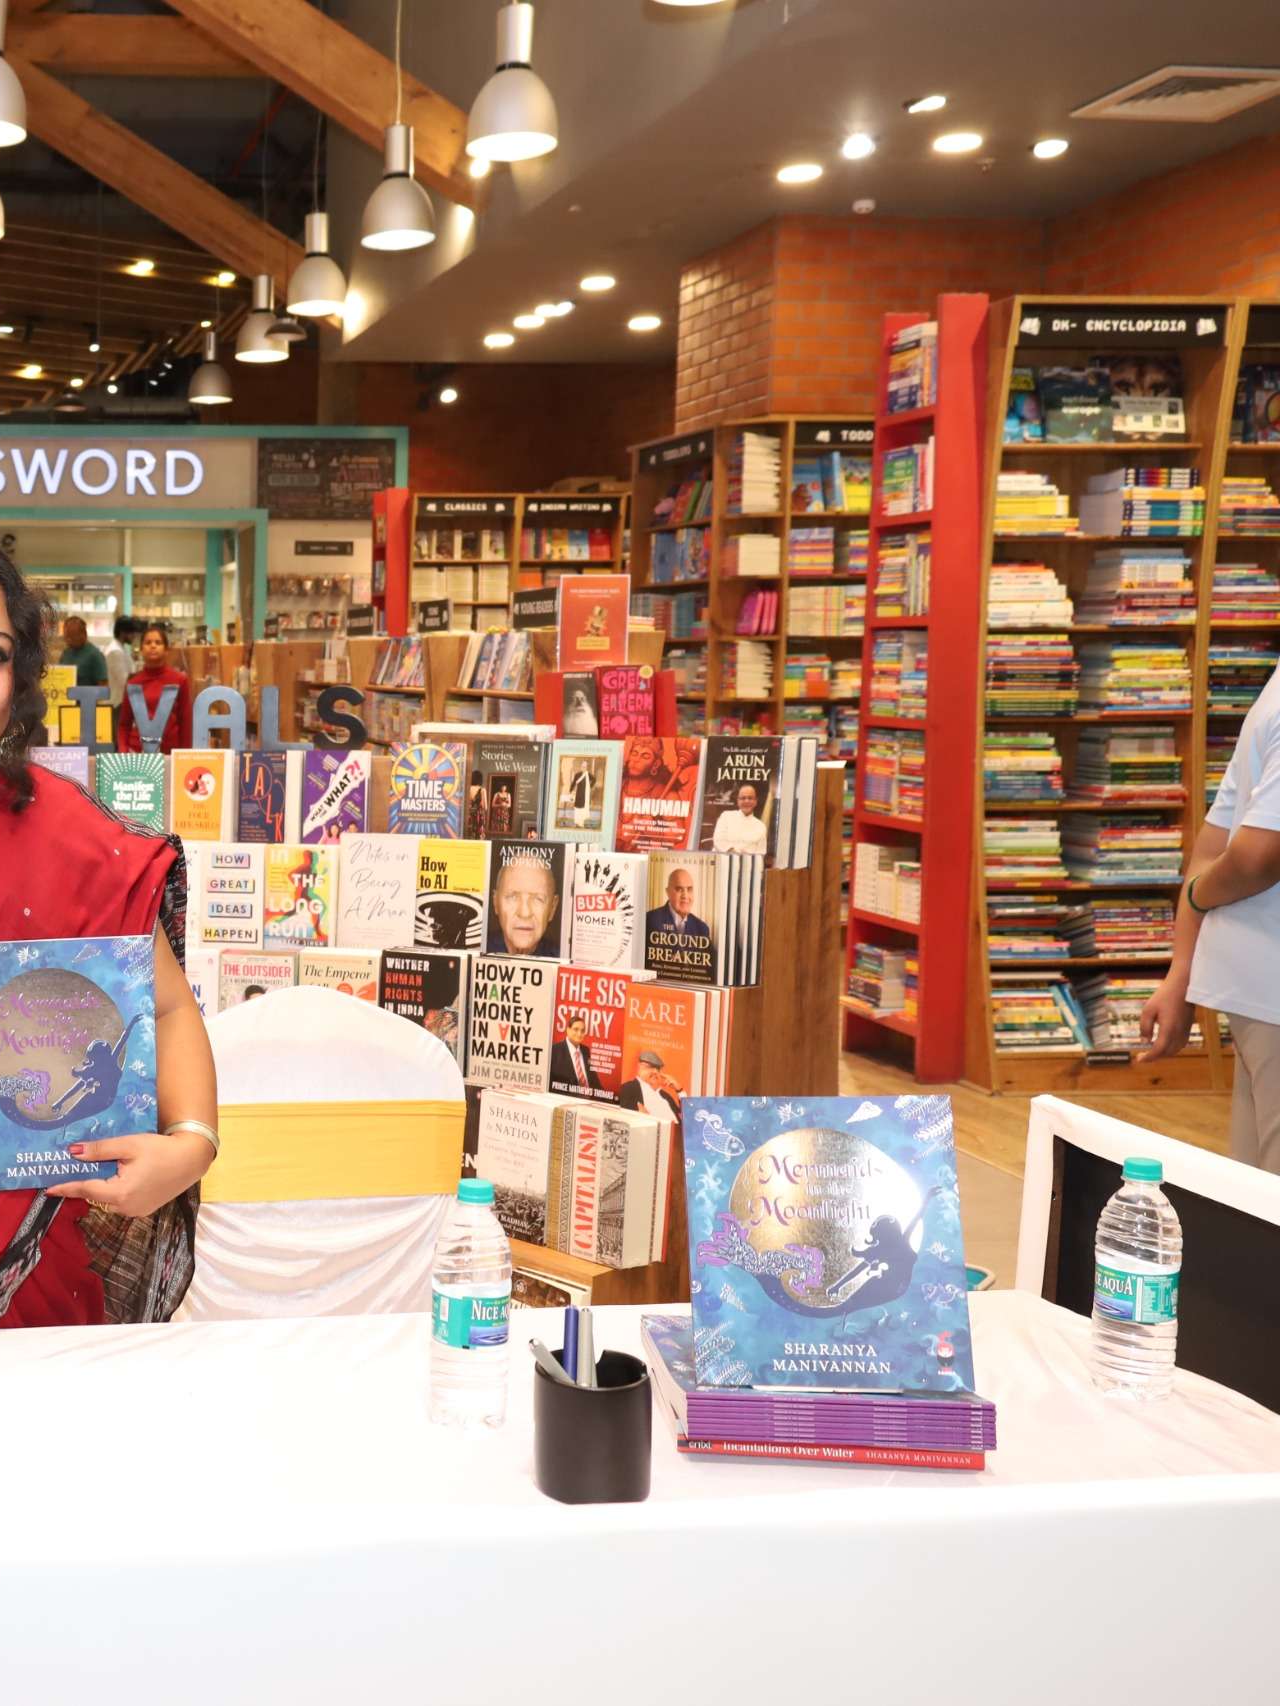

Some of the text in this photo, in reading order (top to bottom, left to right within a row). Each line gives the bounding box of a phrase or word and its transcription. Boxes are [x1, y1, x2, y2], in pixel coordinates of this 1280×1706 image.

[1086, 319, 1186, 332] ENCYCLOPIDIA
[840, 429, 874, 442] TODD
[444, 502, 487, 511] CLASSICS
[601, 671, 652, 690] GREAT
[601, 714, 653, 735] HOTEL
[60, 751, 82, 762] CAN
[480, 749, 514, 762] Stories
[723, 755, 766, 768] ARUN
[494, 760, 538, 774] We Wear
[716, 767, 771, 782] JAITLEY
[112, 780, 154, 792] Manifest
[406, 779, 443, 799] TIME
[116, 791, 151, 802] the Life
[112, 801, 154, 812] You Love
[400, 798, 446, 813] MASTERS
[622, 797, 690, 818] HANUMAN
[215, 854, 246, 864] HOW
[350, 840, 388, 865] Notes
[499, 845, 556, 861] ANTHONY
[420, 856, 448, 873] How
[501, 857, 553, 870] HOPKINS
[209, 879, 250, 890] GREAT
[291, 873, 323, 887] THE
[350, 868, 402, 897] Being
[419, 873, 432, 889] to
[432, 874, 449, 890] AI
[210, 903, 248, 914] IDEAS
[268, 898, 324, 912] LONG
[575, 894, 614, 912] BUSY
[575, 914, 616, 927] WOMEN
[663, 923, 674, 931] THE
[203, 928, 254, 939] HAPPEN
[649, 930, 711, 948] GROUND
[385, 957, 431, 972] WHITHER
[647, 948, 713, 967] BREAKER
[223, 963, 292, 978] THE OUTSIDER
[303, 964, 372, 981] The Emperor
[475, 962, 543, 987] HOW TO
[385, 973, 423, 987] HUMAN
[558, 971, 591, 1004] THE
[384, 989, 424, 1002] RIGHTS
[473, 985, 522, 1005] MAKE
[397, 1002, 425, 1017] INDIA
[472, 1002, 534, 1024] MONEY
[629, 996, 688, 1028] RARE
[555, 1003, 615, 1039] STORY
[472, 1021, 532, 1042] IN ANY
[470, 1038, 544, 1066] MARKET
[470, 1065, 543, 1086] JIM CRAMER
[487, 1105, 539, 1128] SHAKHA
[495, 1123, 540, 1145] NATION
[6, 1161, 101, 1179] MANIVANNAN
[573, 1124, 600, 1250] CAPITALISM
[748, 1196, 873, 1228] Moonlight
[1102, 1275, 1134, 1296] AQUA
[471, 1299, 500, 1322] NICE
[783, 1342, 878, 1358] SHARANYA
[772, 1359, 892, 1374] MANIVANNAN
[722, 1441, 972, 1465] Incantations Over Water SHARANYA MANIVANNAN
